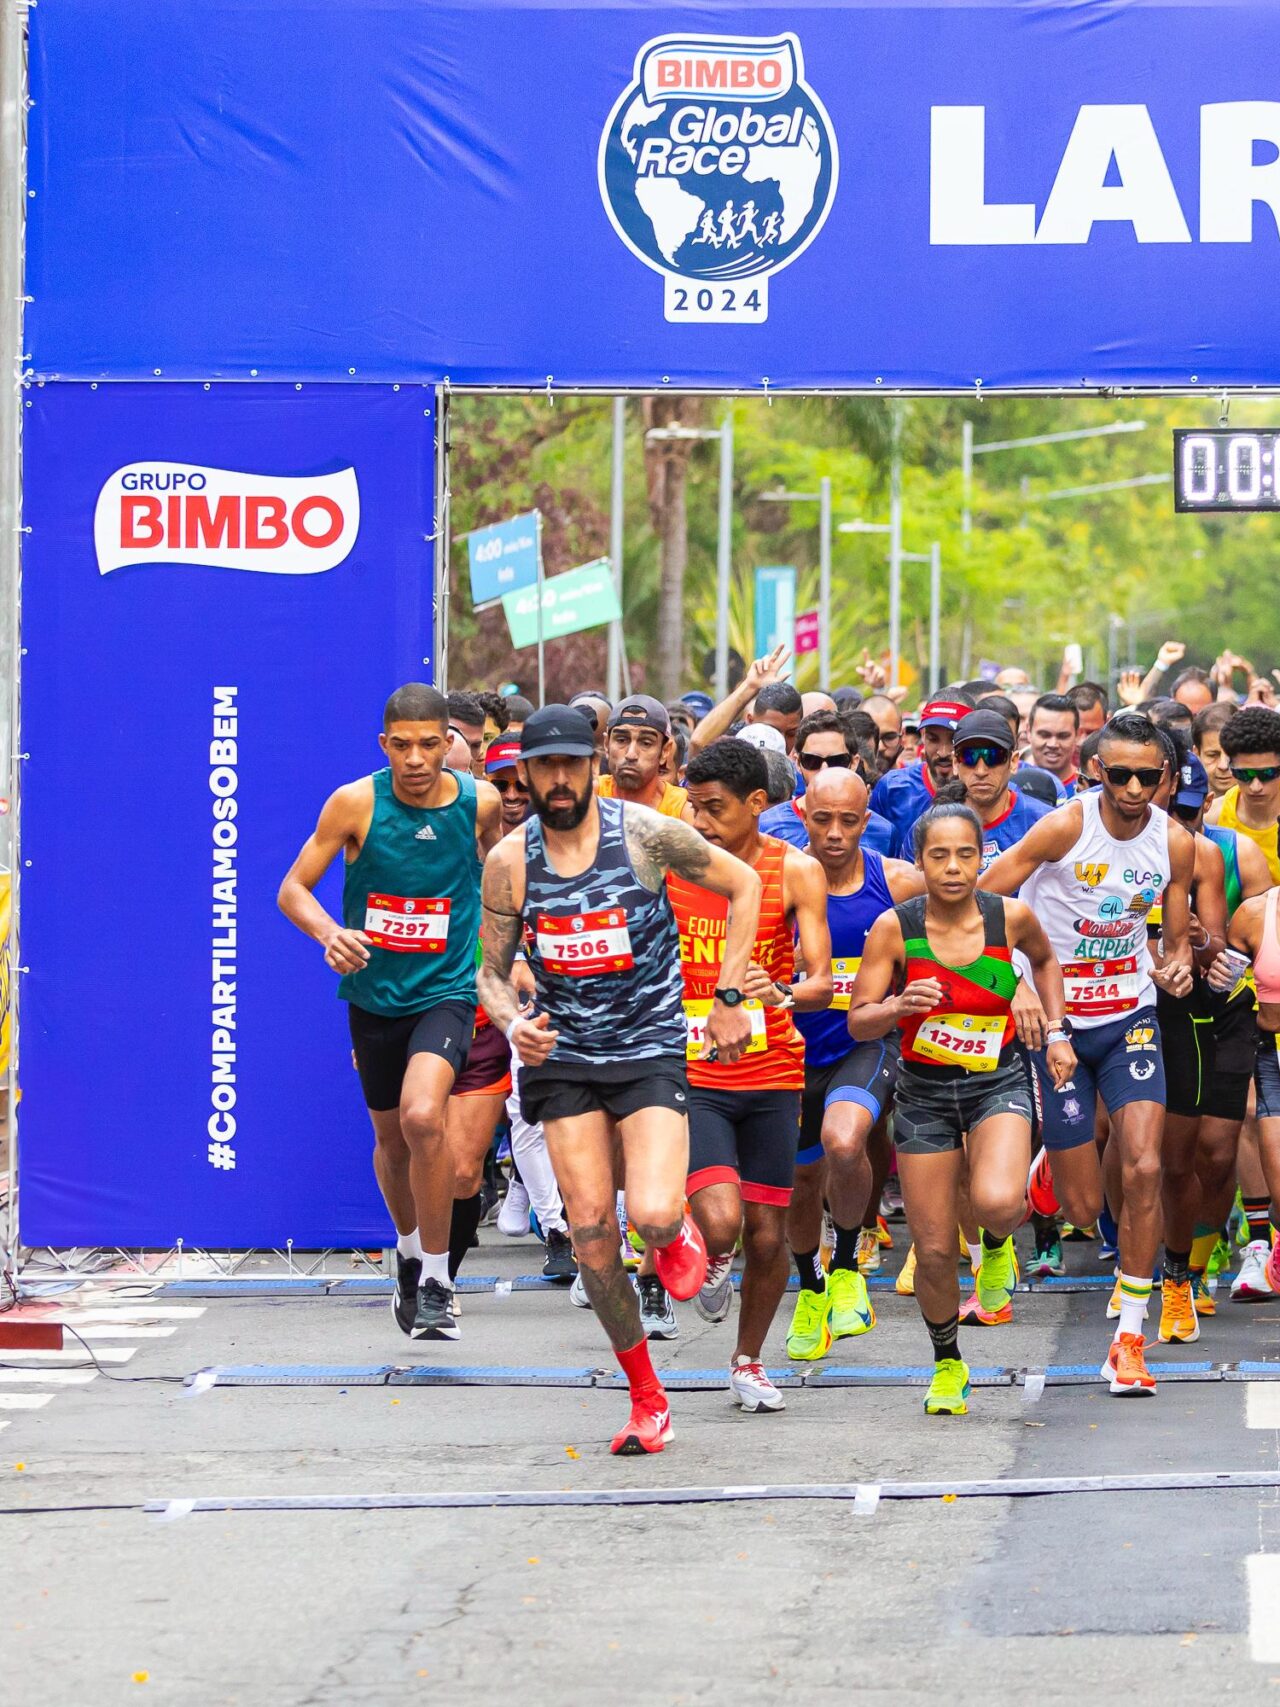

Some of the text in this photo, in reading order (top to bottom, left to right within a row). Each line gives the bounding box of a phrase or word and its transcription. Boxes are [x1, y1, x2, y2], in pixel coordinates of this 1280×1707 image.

[657, 60, 782, 88] BIMBO
[669, 105, 804, 145] Global
[637, 139, 748, 176] Race
[673, 288, 762, 312] 2024
[121, 473, 207, 491] GRUPO
[120, 495, 345, 549] BIMBO
[207, 686, 239, 1171] #COMPARTILHAMOSOBEM
[382, 919, 430, 936] 7297
[688, 915, 726, 939] EQUI
[553, 939, 610, 958] 7506
[1071, 983, 1120, 1000] 7544
[929, 1029, 987, 1055] 12795
